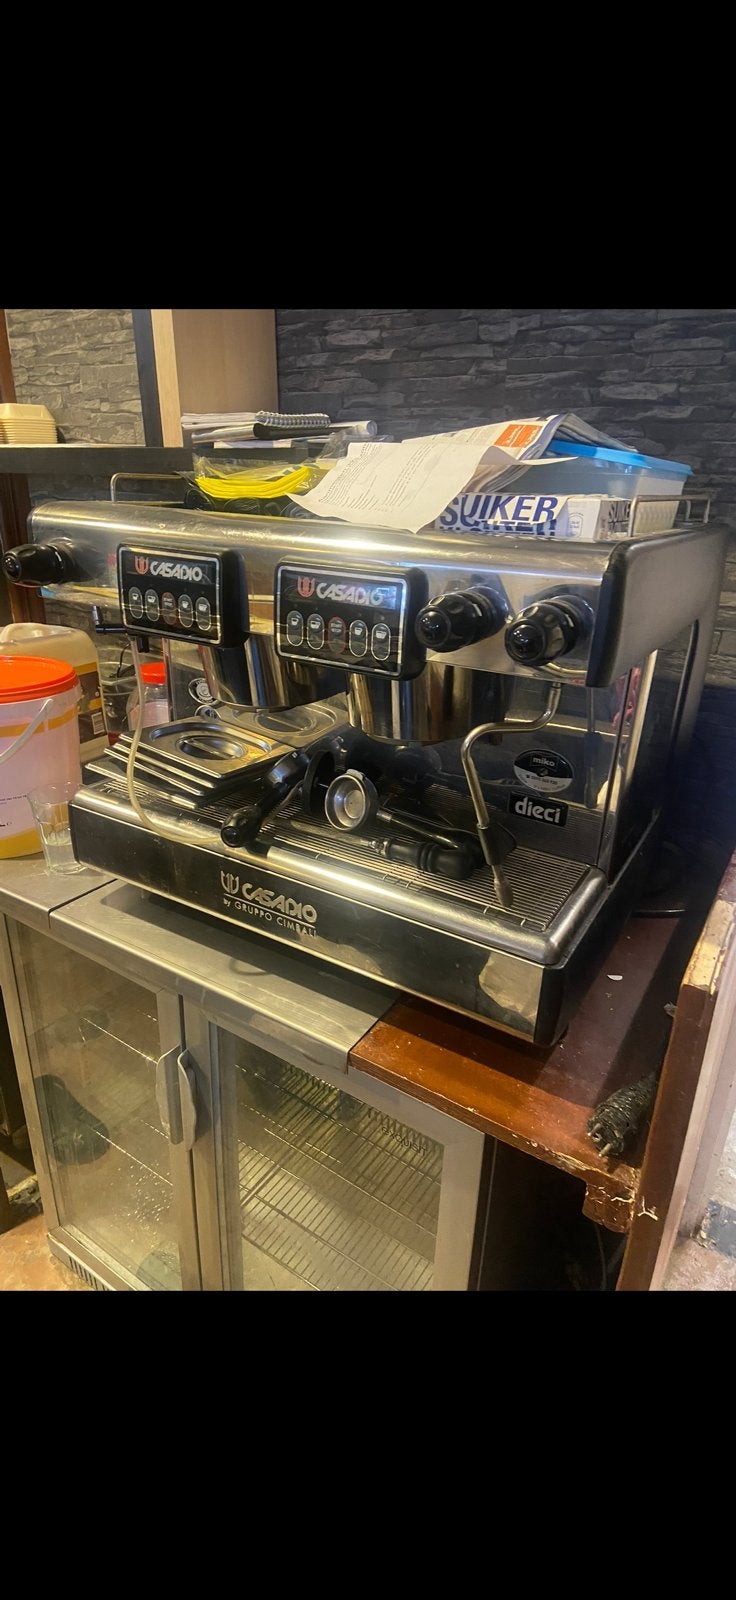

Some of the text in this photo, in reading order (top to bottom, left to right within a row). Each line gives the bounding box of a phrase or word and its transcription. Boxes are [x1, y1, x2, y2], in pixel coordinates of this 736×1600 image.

[440, 495, 558, 526] SUIKER
[608, 501, 633, 520] SUIKE
[150, 561, 203, 582] CASADIO
[316, 583, 384, 606] CASADIO
[532, 757, 556, 767] miko
[515, 797, 561, 824] dieci
[242, 882, 317, 923] CASADIO
[234, 901, 273, 921] GRUPPO
[276, 917, 317, 938] CIMBALI
